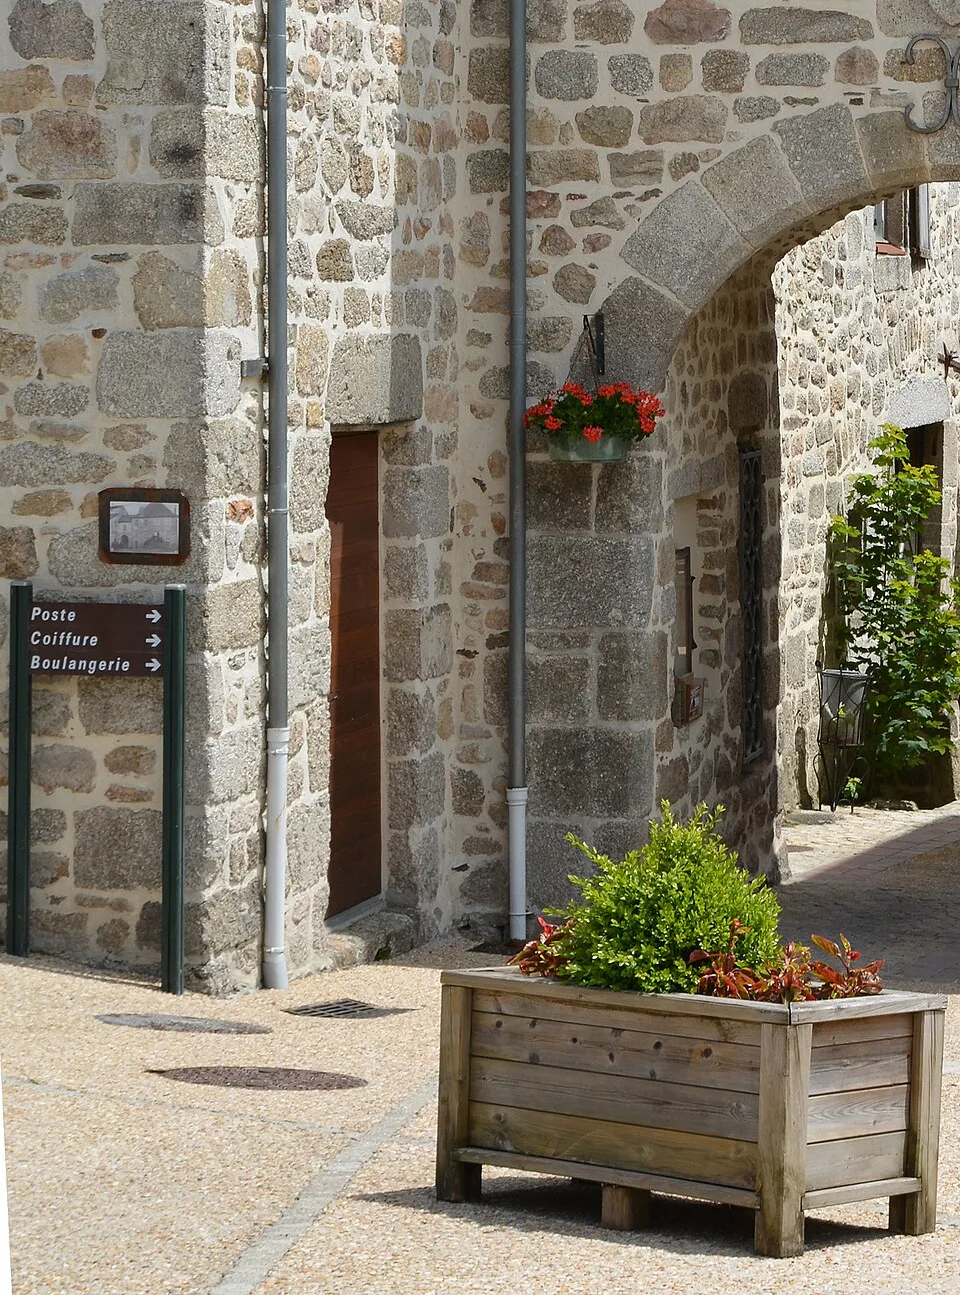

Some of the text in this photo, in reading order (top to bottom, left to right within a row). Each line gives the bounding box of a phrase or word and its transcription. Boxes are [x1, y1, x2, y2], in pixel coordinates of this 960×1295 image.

[30, 607, 76, 621] Poste
[30, 631, 98, 646] Coiffure
[30, 655, 130, 674] Boulangerie
